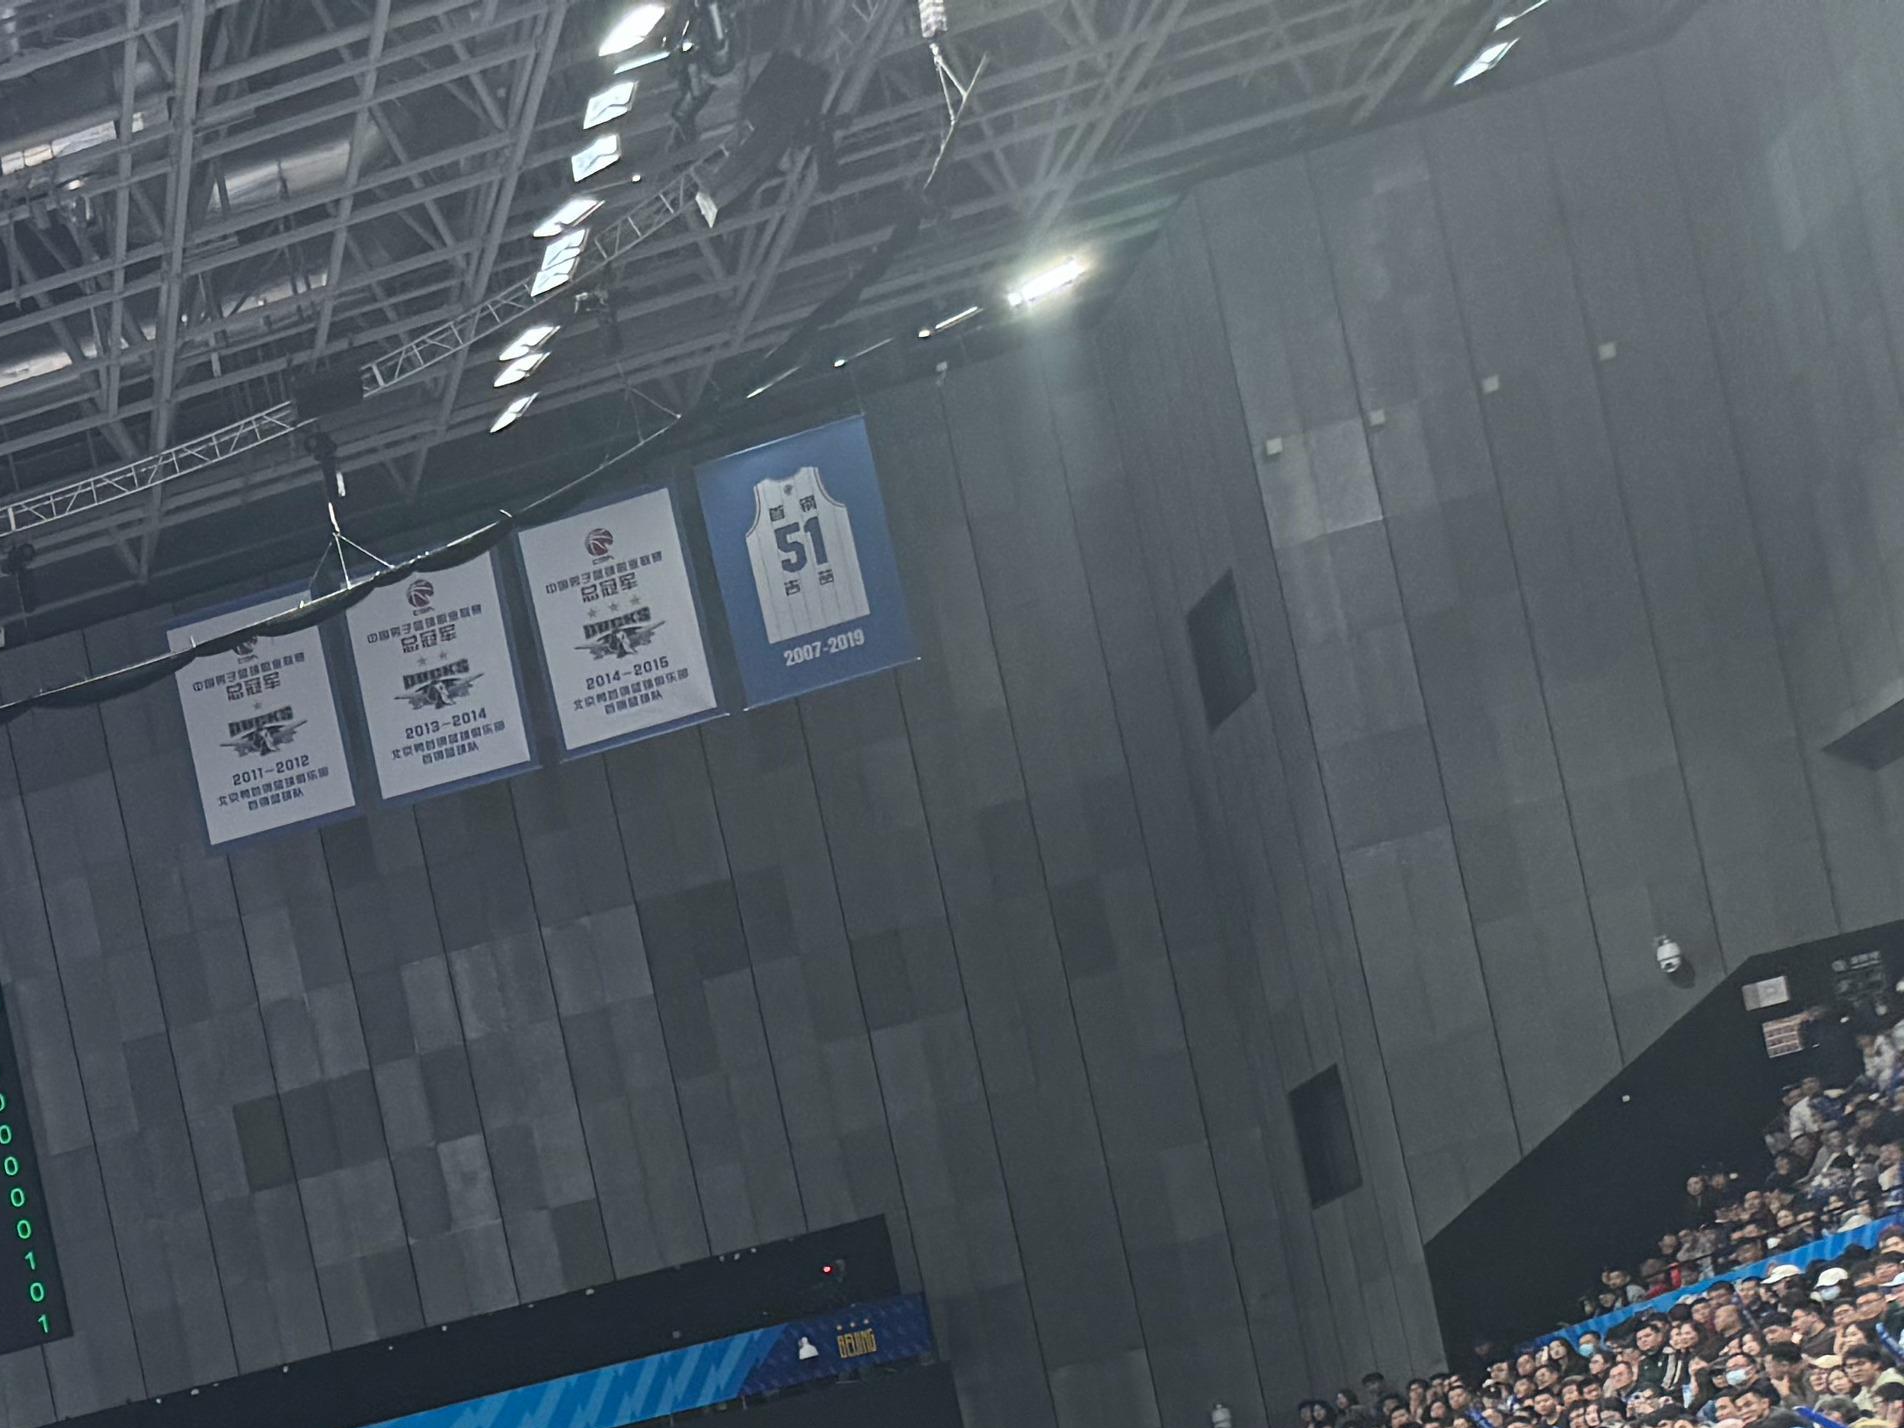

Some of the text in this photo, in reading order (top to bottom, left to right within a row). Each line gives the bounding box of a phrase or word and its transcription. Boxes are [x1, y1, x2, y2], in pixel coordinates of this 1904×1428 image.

[774, 516, 828, 573] 51
[581, 572, 637, 603] 总冠军
[583, 606, 652, 640] DUCKS
[401, 624, 457, 653] 总冠军
[784, 628, 865, 667] 2007-2019
[226, 671, 280, 701] 总冠军
[403, 658, 470, 690] DUCKS
[228, 705, 294, 738] DUCKS
[4, 1156, 19, 1176] 0
[10, 1187, 25, 1207] 0
[16, 1219, 31, 1239] 0
[25, 1251, 36, 1270] 1
[29, 1282, 44, 1302] 0
[38, 1313, 48, 1333] 1
